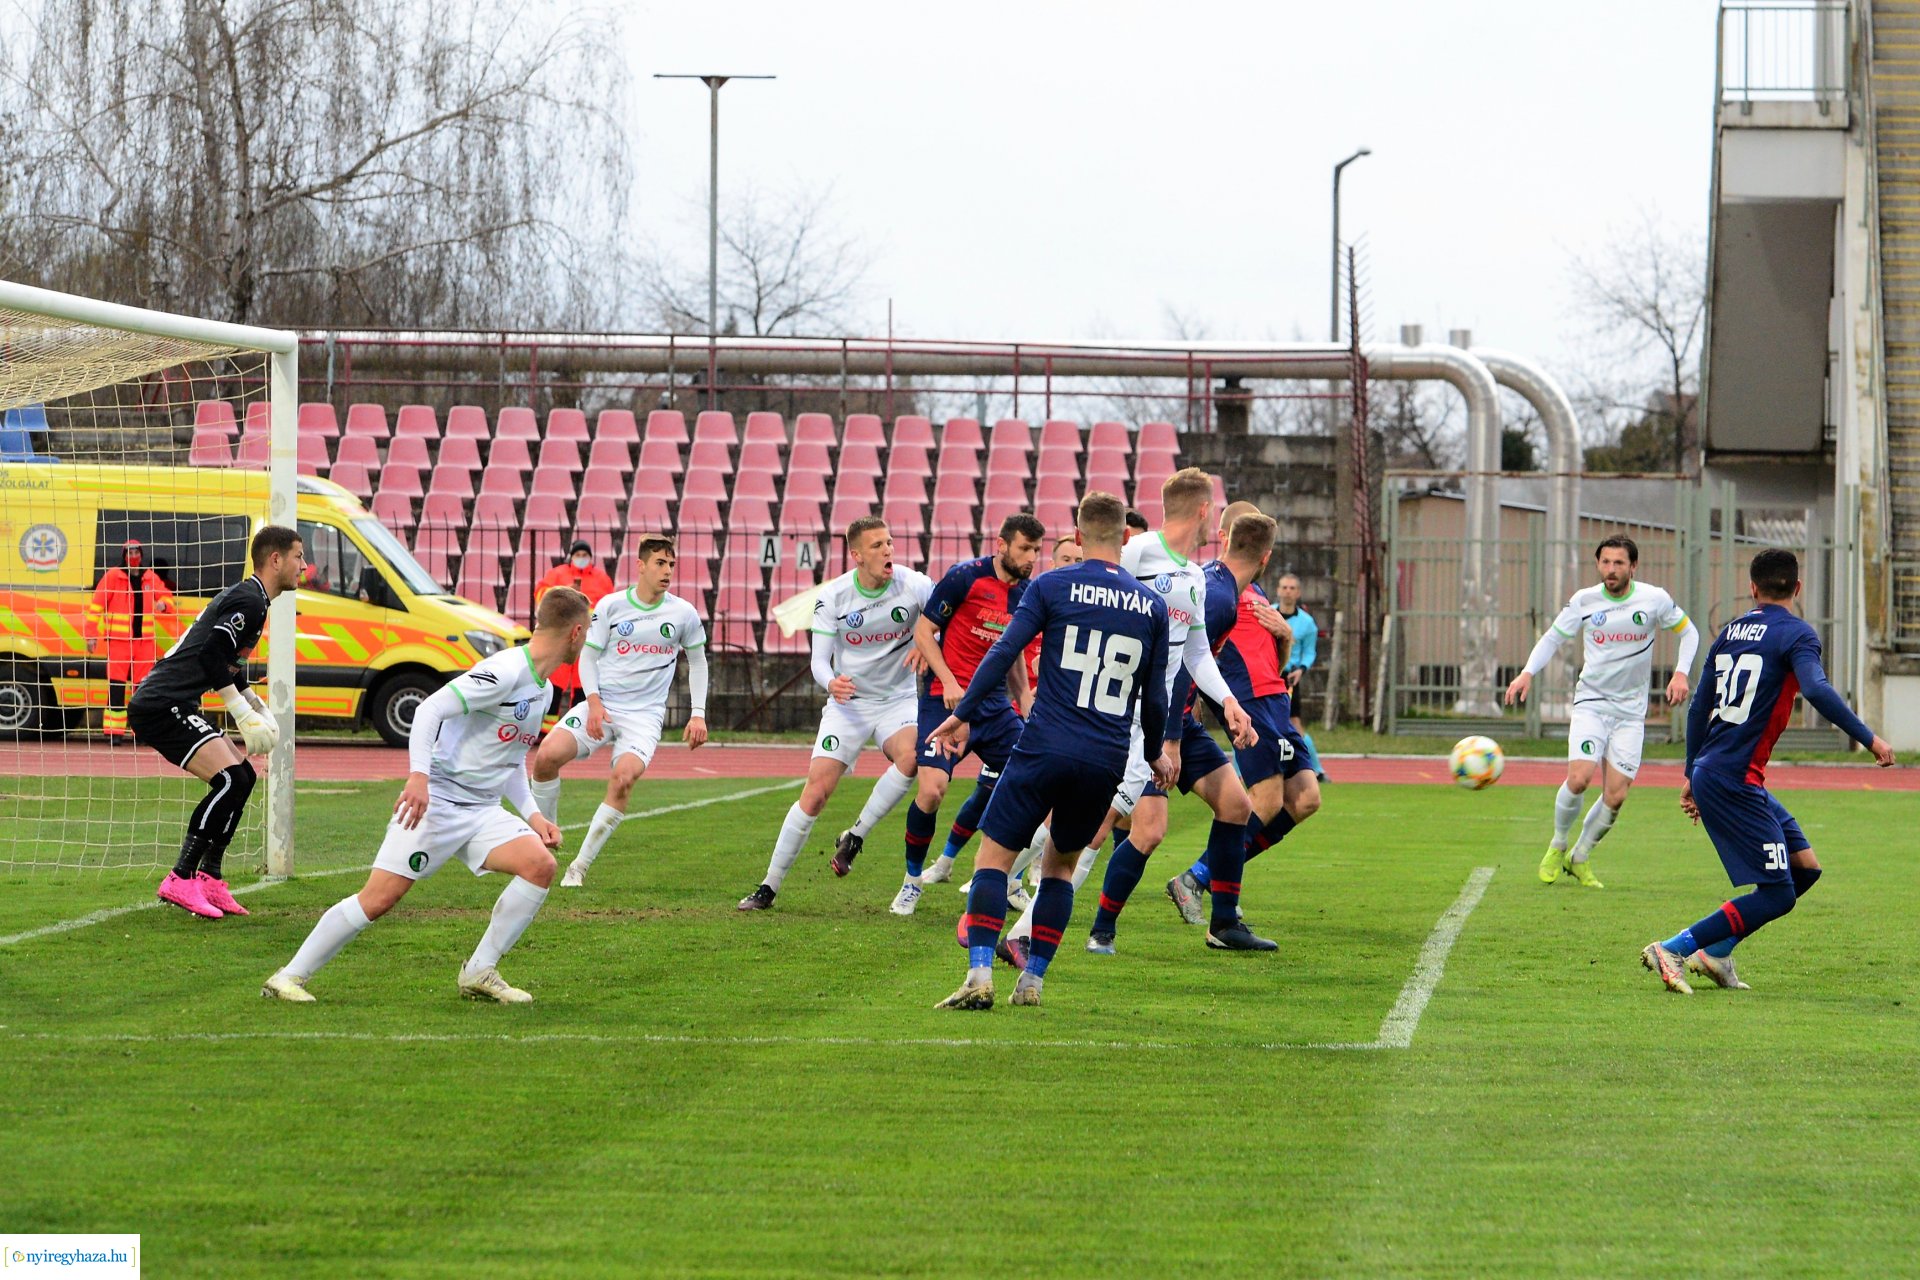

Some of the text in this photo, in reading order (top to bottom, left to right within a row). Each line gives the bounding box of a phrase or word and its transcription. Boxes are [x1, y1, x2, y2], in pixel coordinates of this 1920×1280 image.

[763, 538, 777, 563] A
[800, 543, 812, 567] A
[1070, 582, 1154, 617] HORNYÁK
[865, 627, 911, 643] VEOLIA
[1607, 633, 1648, 642] VEOLIA
[1726, 623, 1768, 642] YAMED
[633, 644, 674, 655] VEOLIA
[1060, 624, 1143, 717] 48
[1711, 653, 1763, 725] 30
[1278, 738, 1295, 762] 15
[1763, 842, 1788, 870] 30
